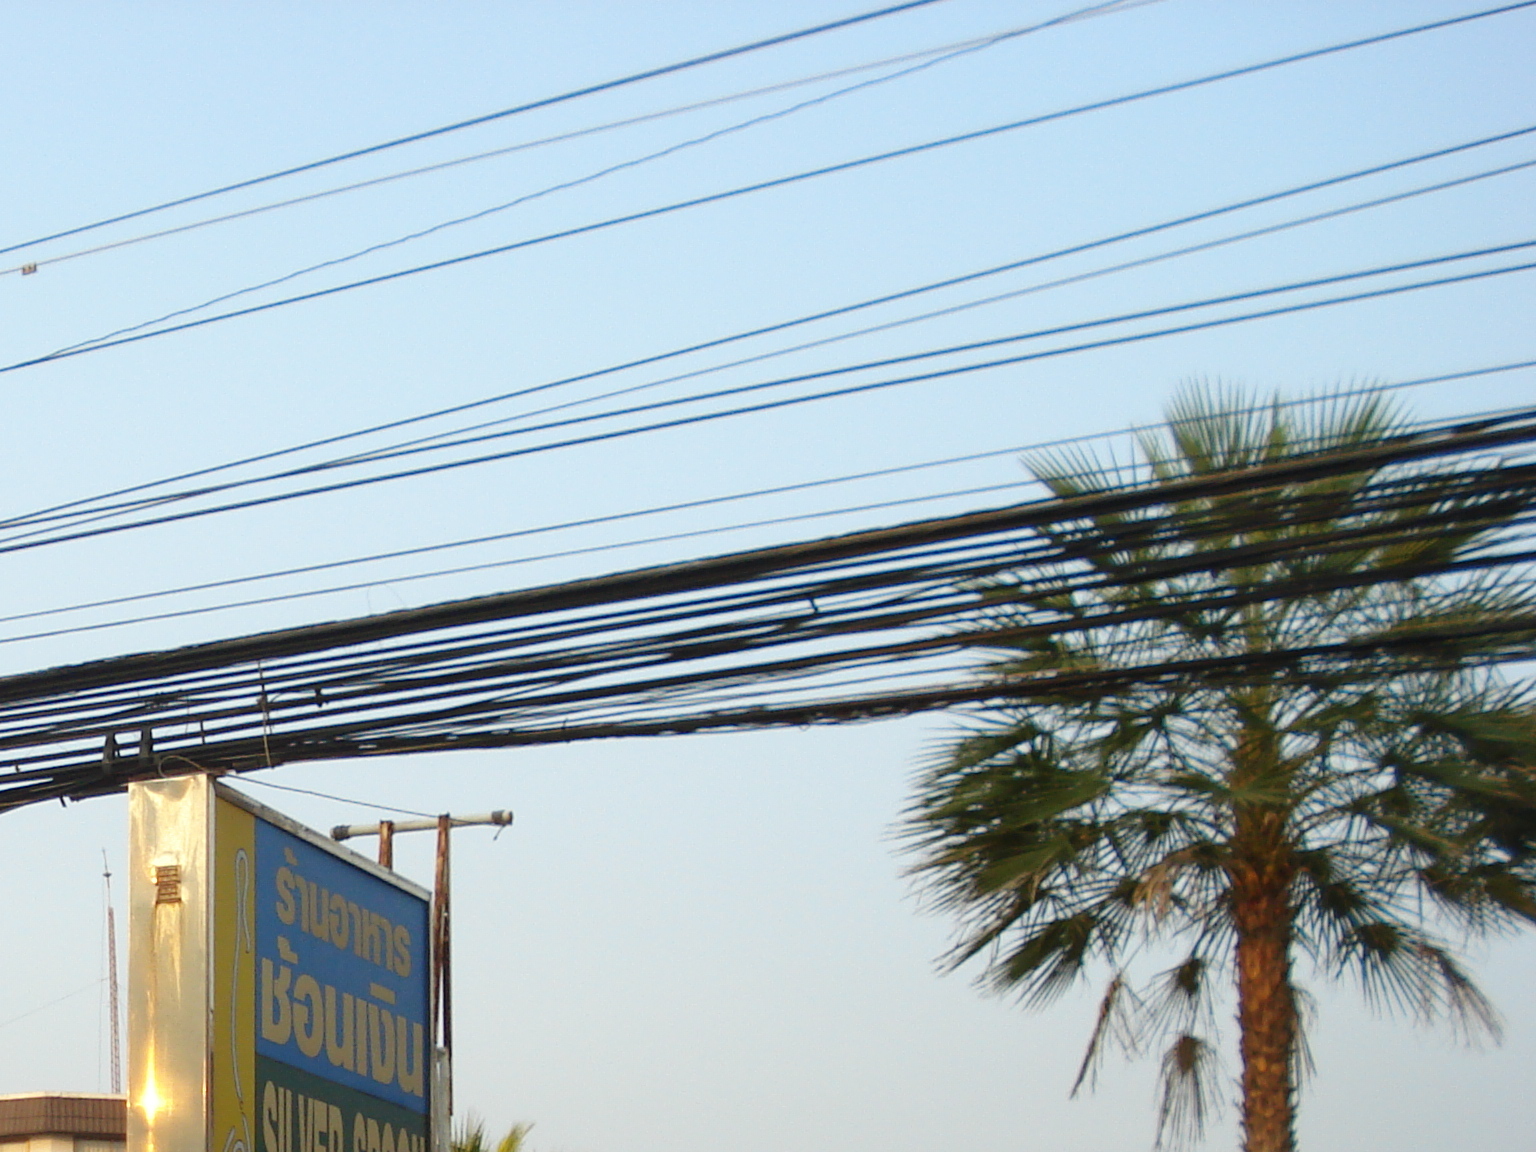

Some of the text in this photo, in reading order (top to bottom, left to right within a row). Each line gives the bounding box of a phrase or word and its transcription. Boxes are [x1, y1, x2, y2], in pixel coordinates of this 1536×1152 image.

[275, 848, 411, 977] ร้านอาหาร
[261, 936, 424, 1097] ช้อนเงิน
